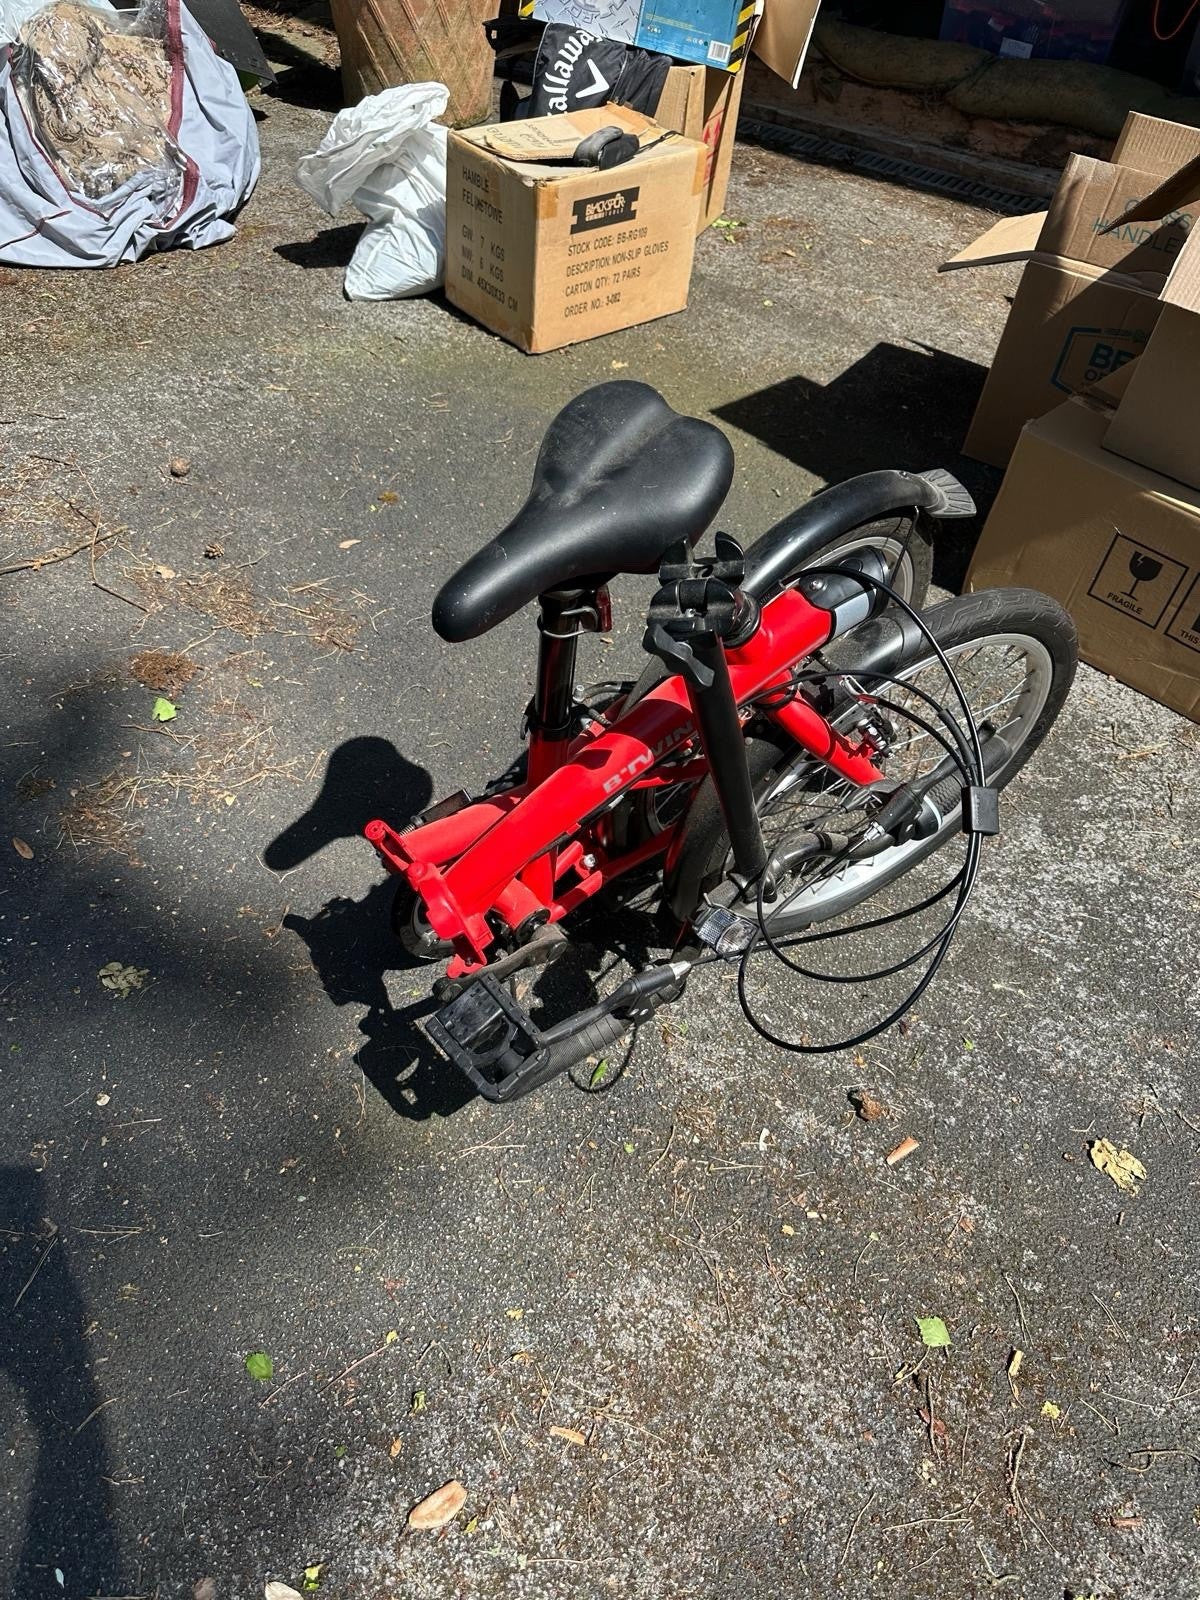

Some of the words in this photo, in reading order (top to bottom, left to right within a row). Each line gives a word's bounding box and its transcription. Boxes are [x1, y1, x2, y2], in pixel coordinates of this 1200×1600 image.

[462, 166, 490, 193] HAMBLE
[490, 241, 505, 262] KGS
[567, 241, 591, 257] STOCK
[593, 235, 615, 250] CODE:
[566, 256, 610, 277] DESCRIPTION:
[611, 247, 642, 266] NON-SLIP
[643, 240, 669, 257] GLOVES
[489, 263, 504, 282] KGS
[565, 280, 593, 297] CARTON
[595, 276, 611, 289] QTY:
[612, 272, 621, 284] 72
[622, 266, 641, 281] PAIRS
[508, 295, 518, 312] CM
[564, 301, 588, 318] ORDER
[1107, 592, 1143, 615] FRAGILE
[1181, 629, 1200, 645] THIS
